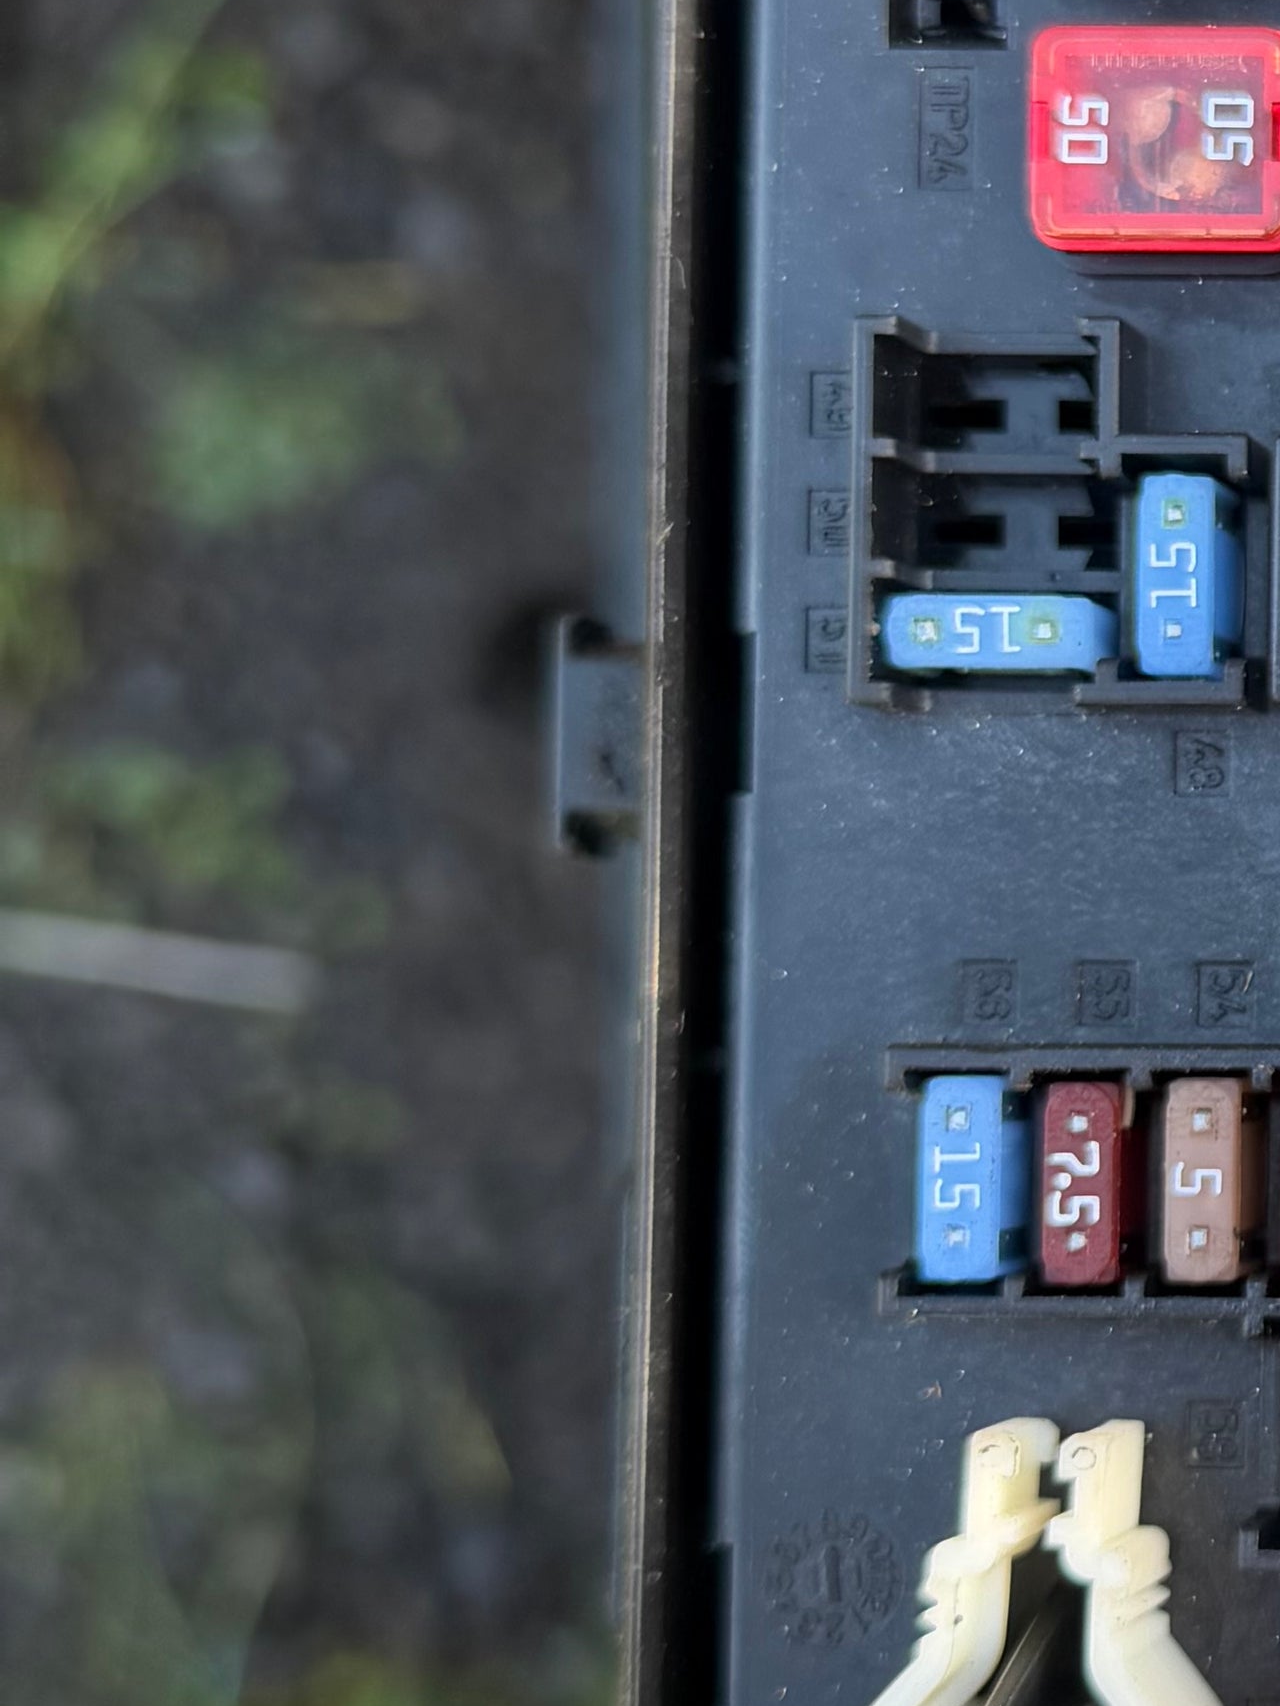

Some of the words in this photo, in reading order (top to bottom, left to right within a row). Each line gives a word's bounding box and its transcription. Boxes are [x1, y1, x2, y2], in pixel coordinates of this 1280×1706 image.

[1059, 96, 1109, 164] 50
[1204, 96, 1254, 166] 50
[1151, 542, 1197, 609] 15
[953, 605, 1021, 653] 15
[931, 1143, 980, 1207] 15
[1046, 1141, 1100, 1226] 7.5
[1175, 1164, 1223, 1197] 5
